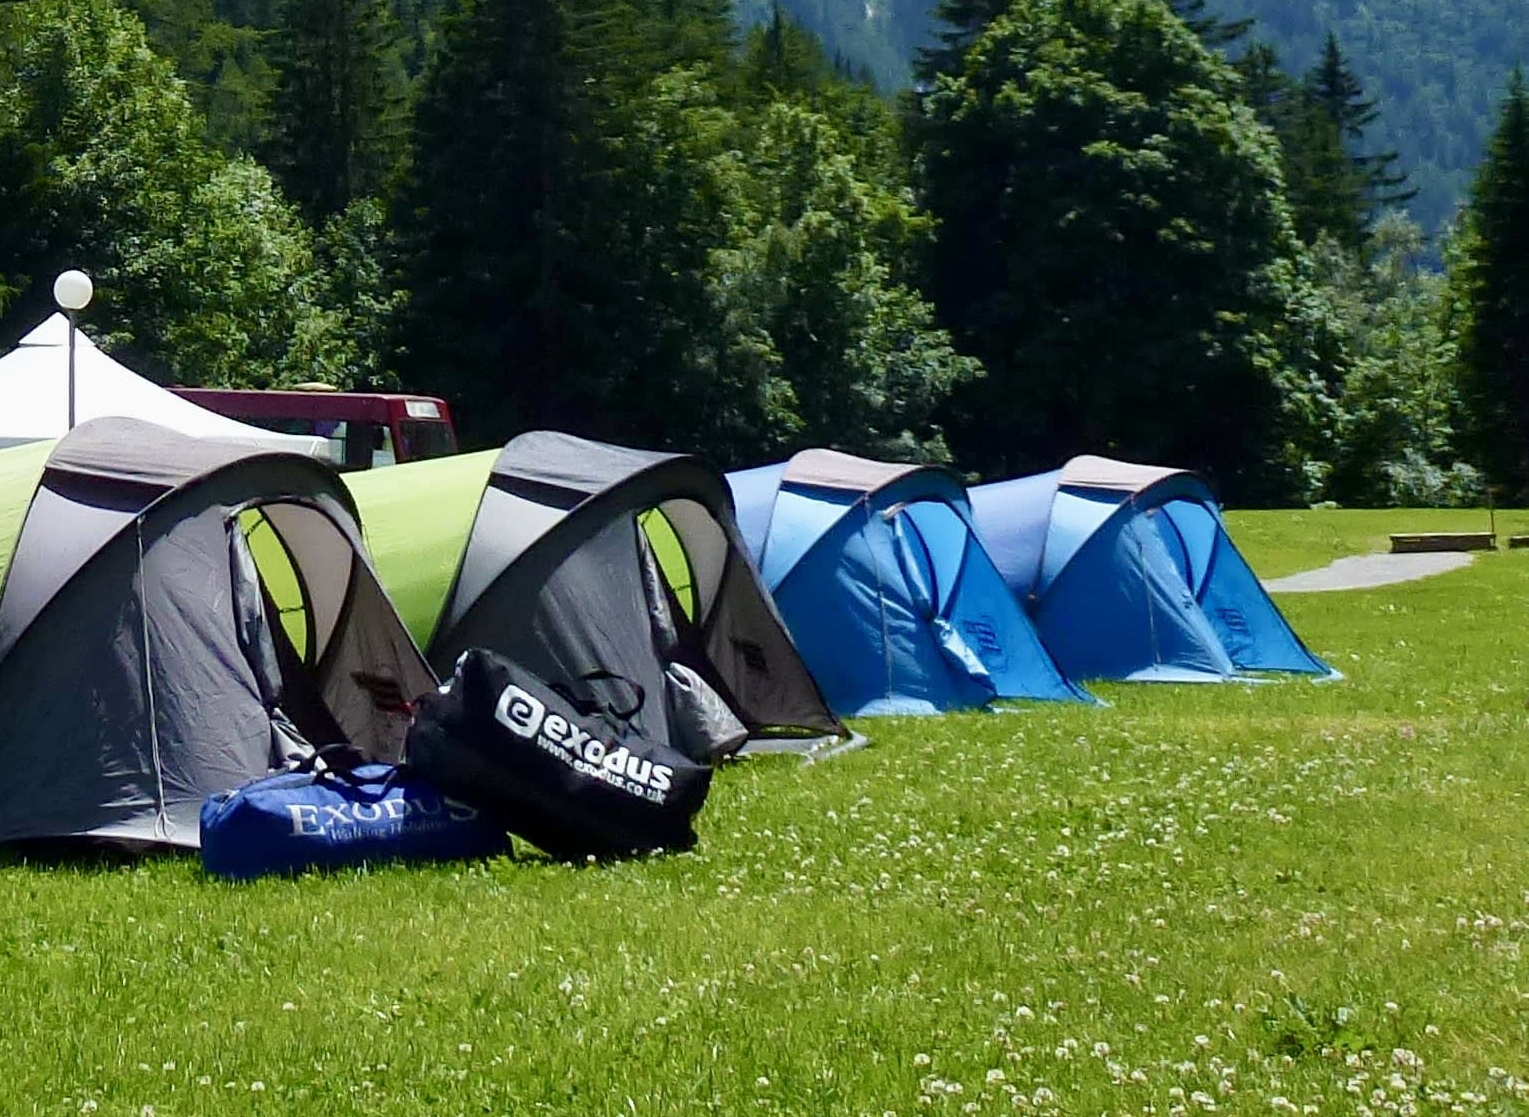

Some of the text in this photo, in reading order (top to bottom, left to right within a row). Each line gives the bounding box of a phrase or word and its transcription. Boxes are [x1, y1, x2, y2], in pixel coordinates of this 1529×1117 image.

[537, 734, 667, 804] www.exodus.co.uk
[543, 714, 674, 791] exodus
[285, 795, 479, 836] EXODUS
